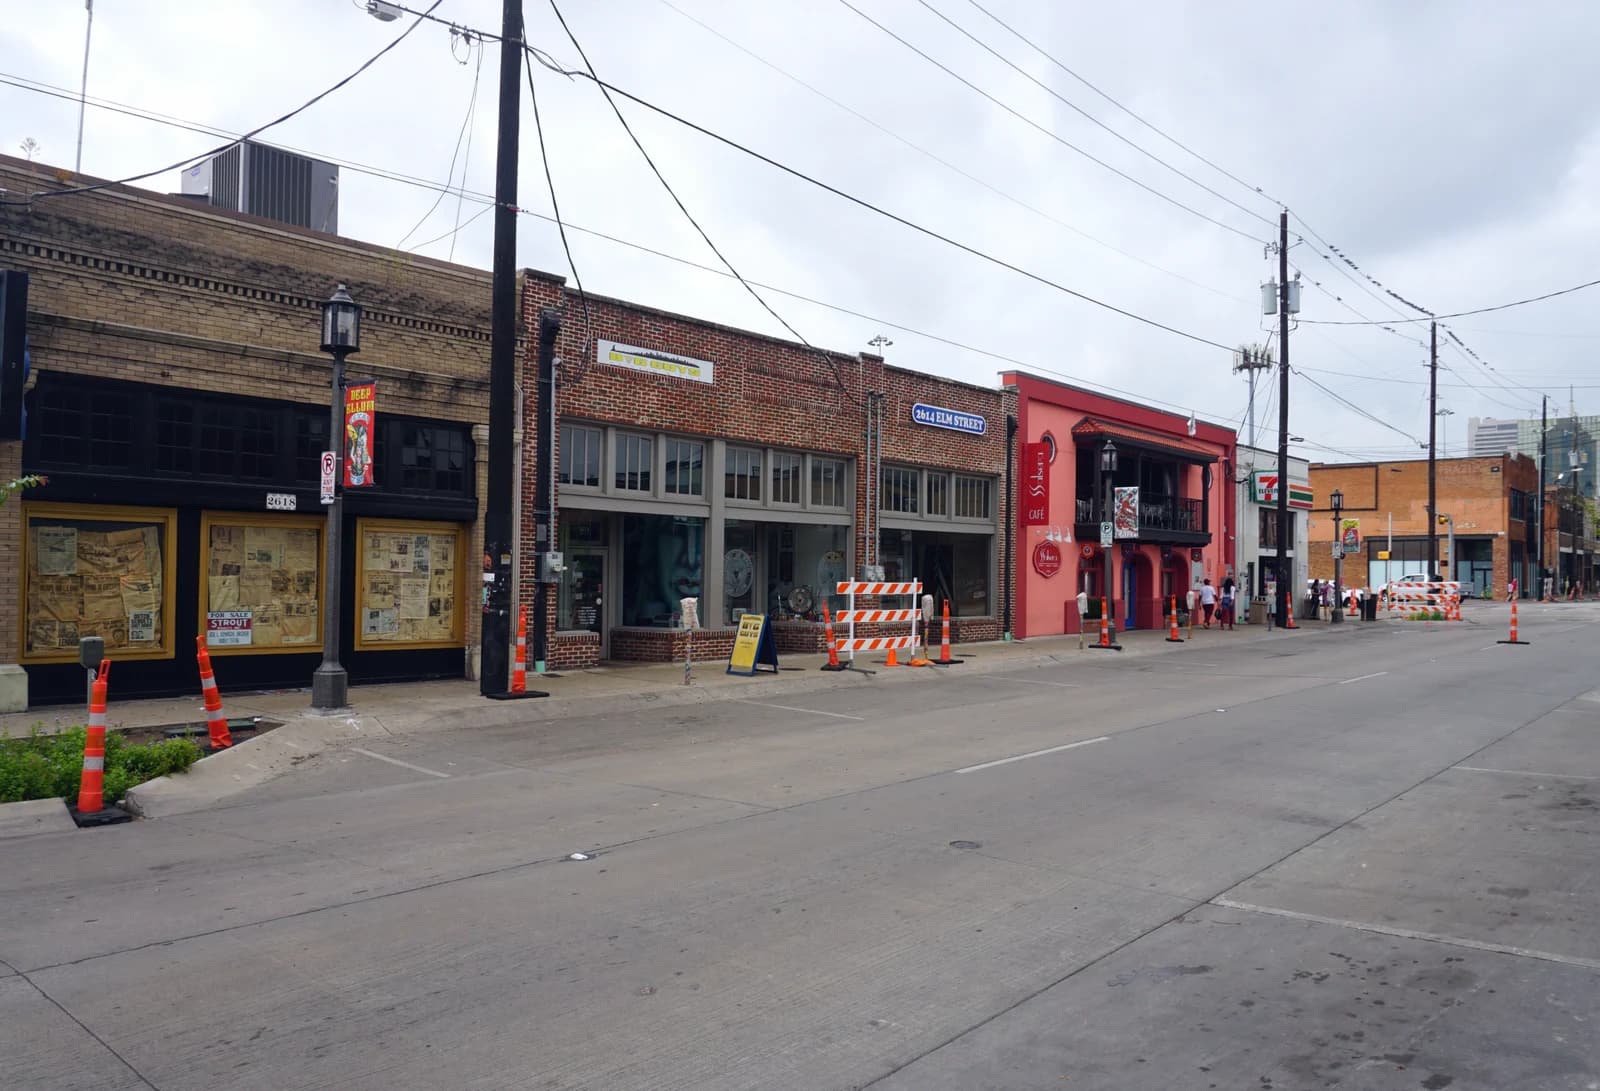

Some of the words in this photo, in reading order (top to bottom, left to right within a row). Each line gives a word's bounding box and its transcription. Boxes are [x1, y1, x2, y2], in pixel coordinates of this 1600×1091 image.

[350, 387, 371, 401] DEEP
[346, 400, 375, 414] ELLUM
[915, 408, 935, 423] 2614
[935, 411, 953, 425] ELM
[953, 415, 984, 431] STREET
[1258, 476, 1278, 501] 7
[267, 496, 296, 506] 2618
[1029, 507, 1044, 520] CAFÉ
[211, 619, 248, 628] STROUT
